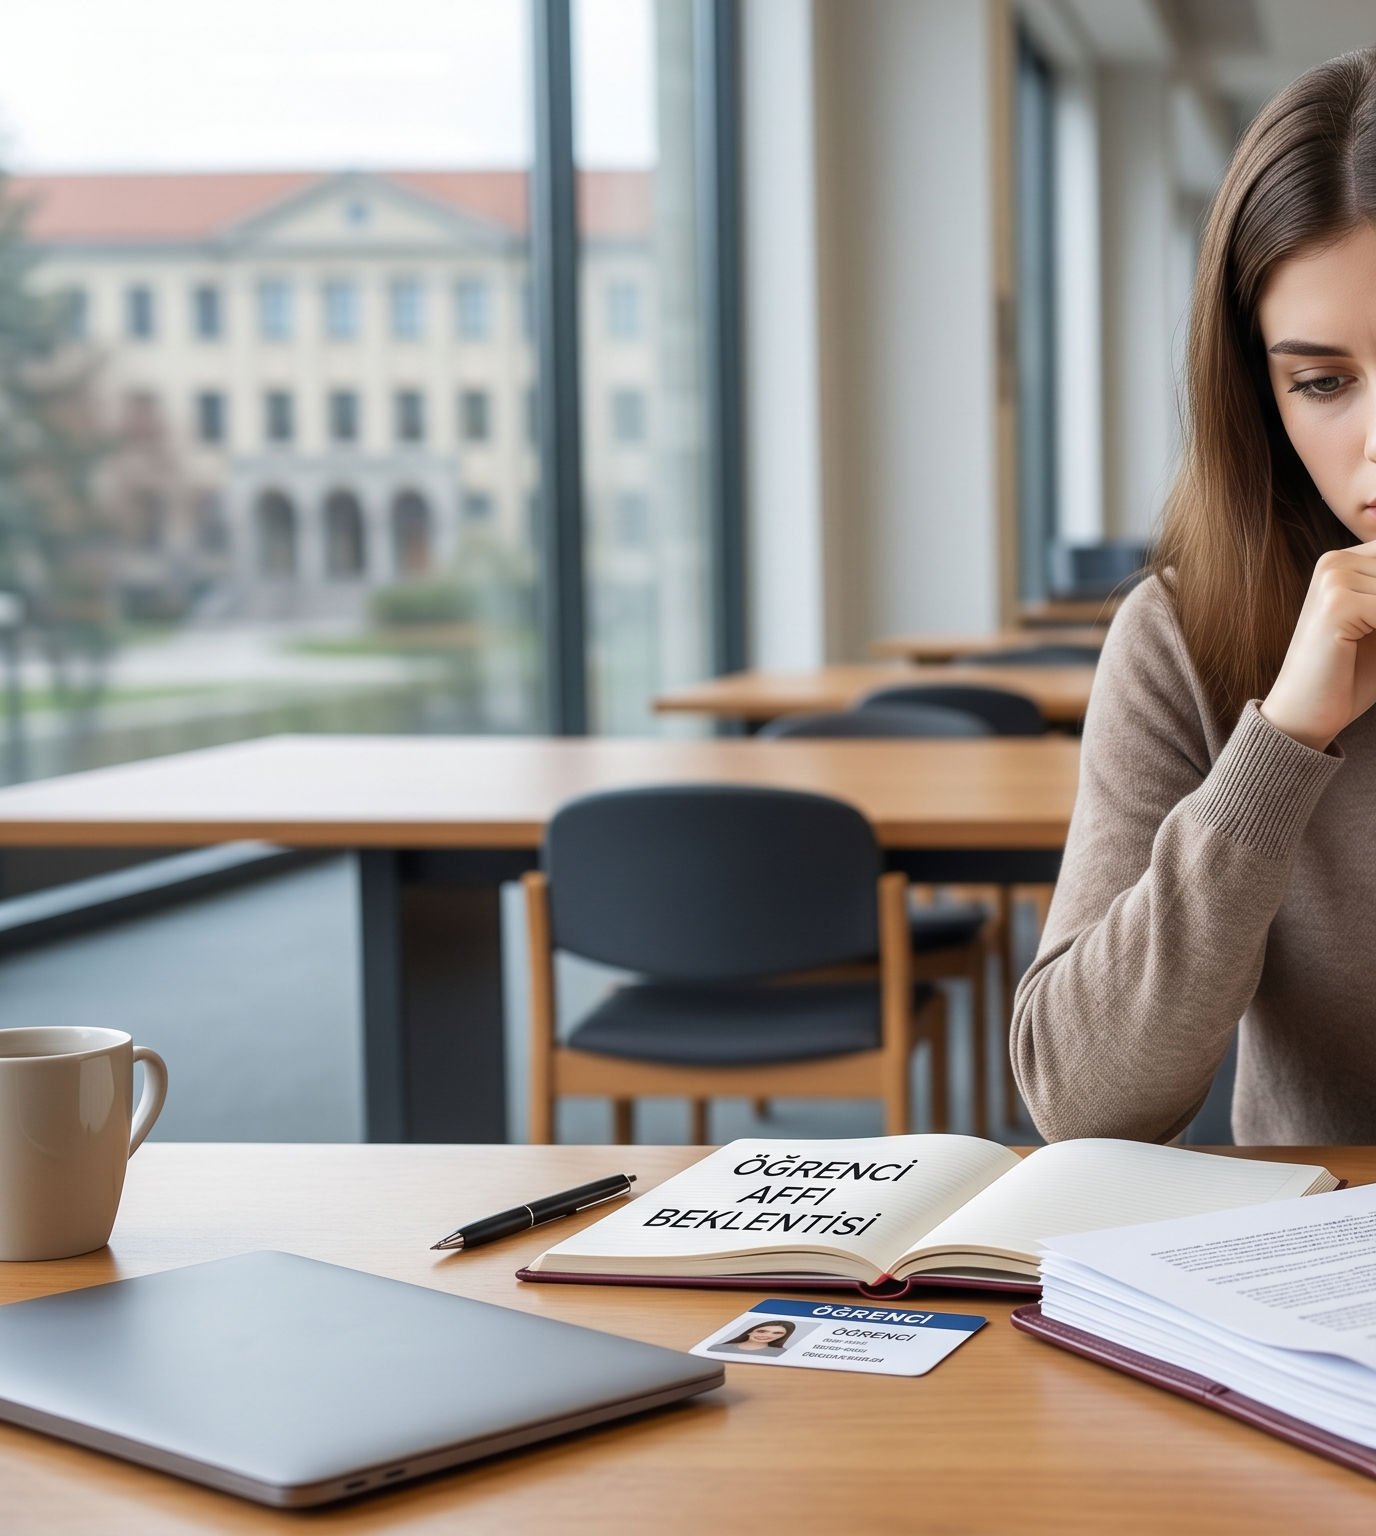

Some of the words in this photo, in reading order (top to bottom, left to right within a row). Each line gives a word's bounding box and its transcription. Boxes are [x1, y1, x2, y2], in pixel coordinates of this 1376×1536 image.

[733, 1154, 918, 1182] ÖĞRENCİ
[736, 1185, 836, 1206] AFFI
[642, 1208, 882, 1236] BEKLENTİSİ
